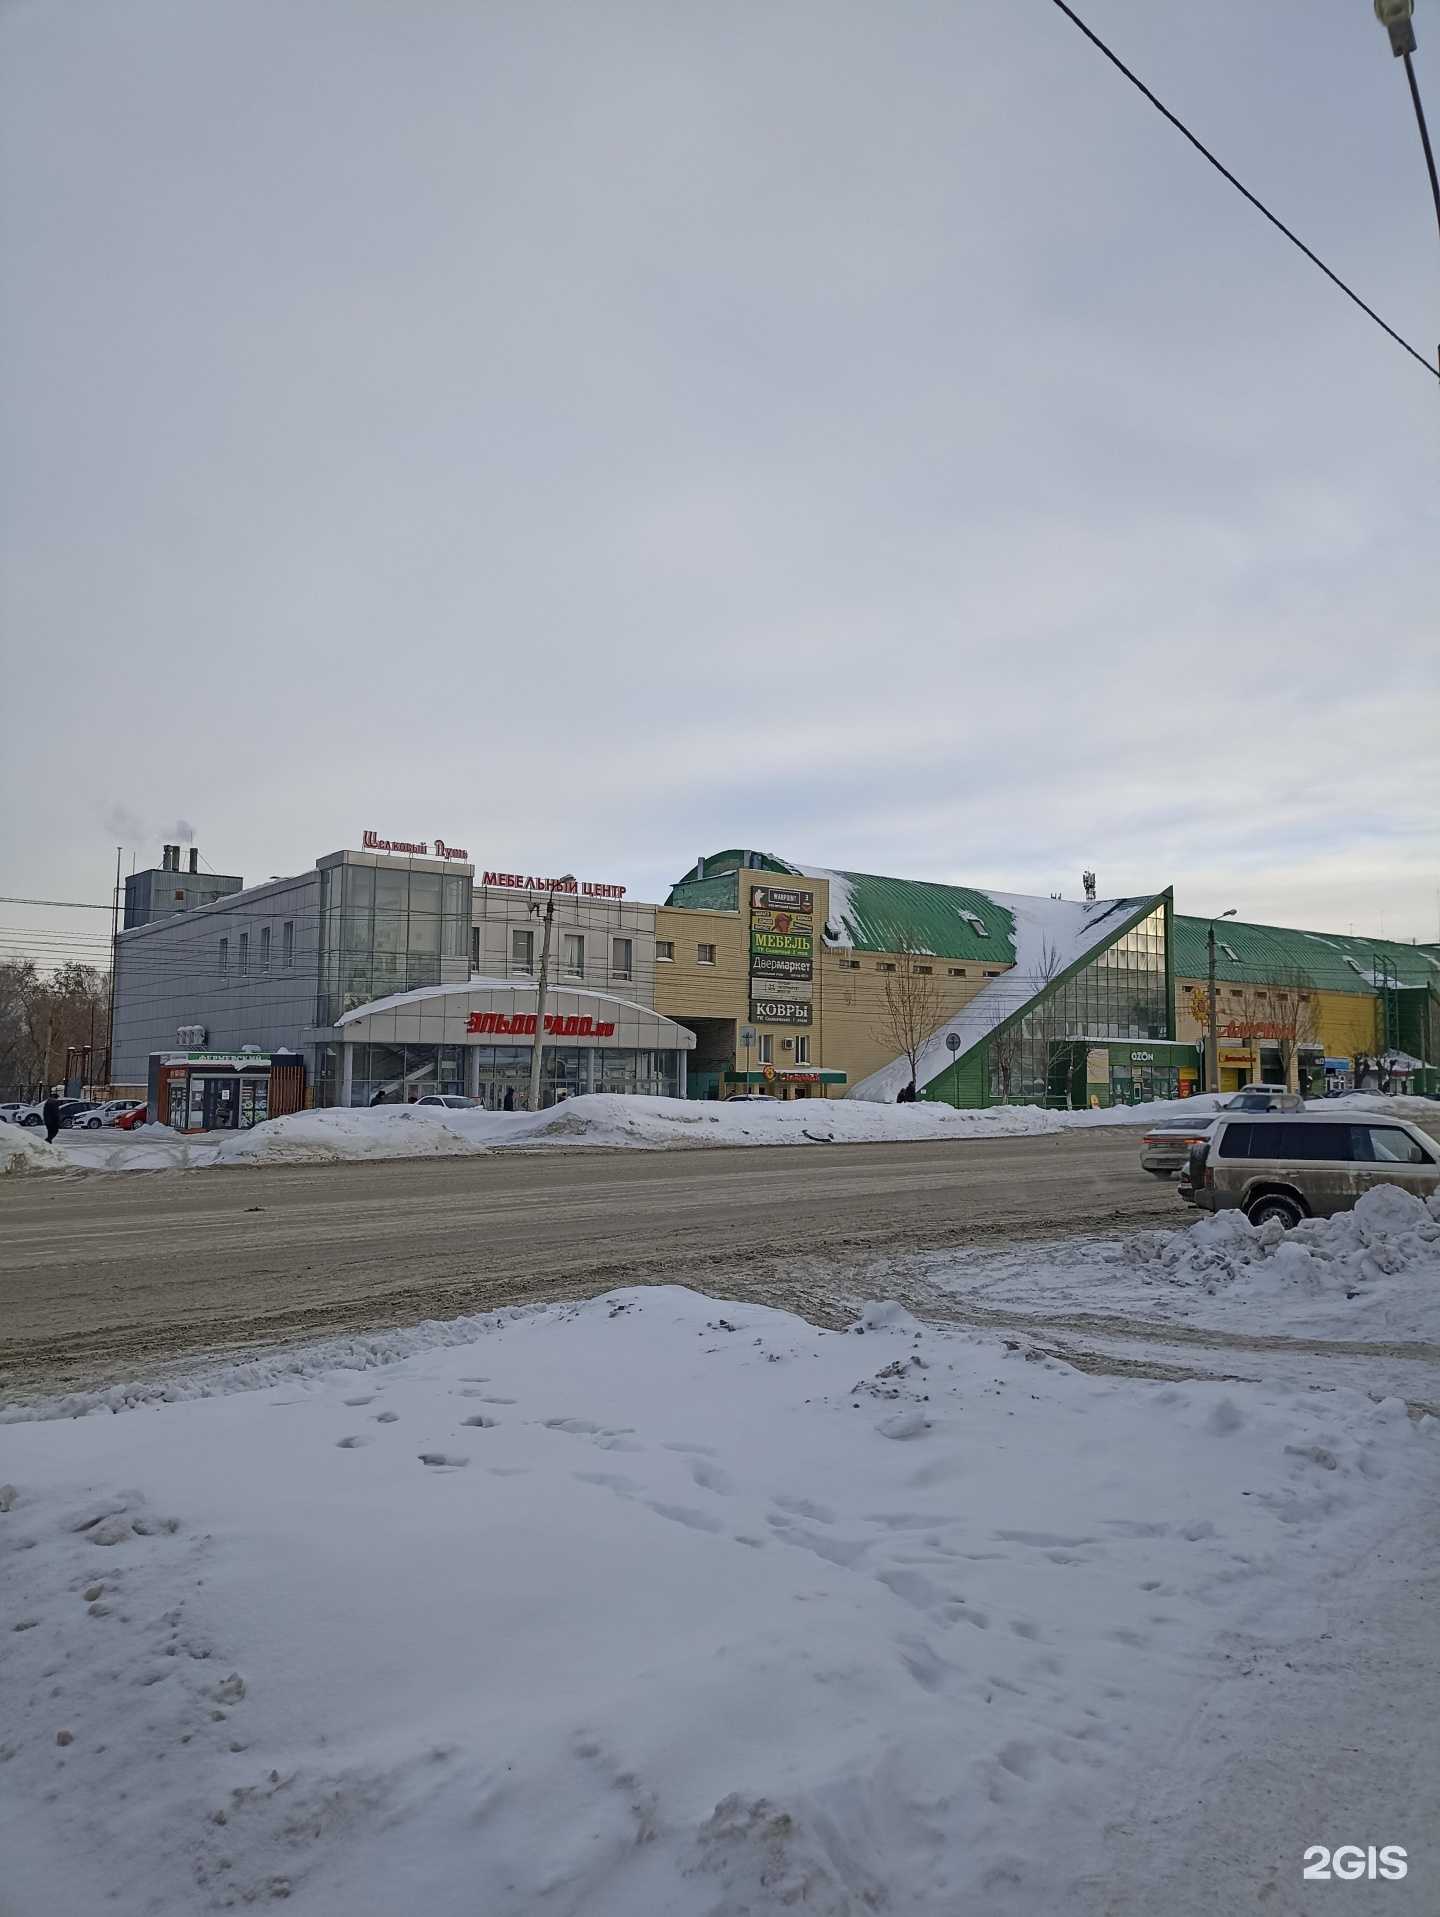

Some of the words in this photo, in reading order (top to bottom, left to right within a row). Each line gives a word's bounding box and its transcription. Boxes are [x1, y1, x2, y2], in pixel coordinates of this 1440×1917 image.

[483, 871, 578, 894] МЕБЕЛЬНЫЙ
[582, 881, 627, 899] ЦЕНТР
[755, 933, 810, 950] МЕБЕЛЬ
[753, 956, 811, 973] Двермаркет
[756, 1002, 809, 1018] КОВРЫ
[1131, 1051, 1154, 1061] OZON
